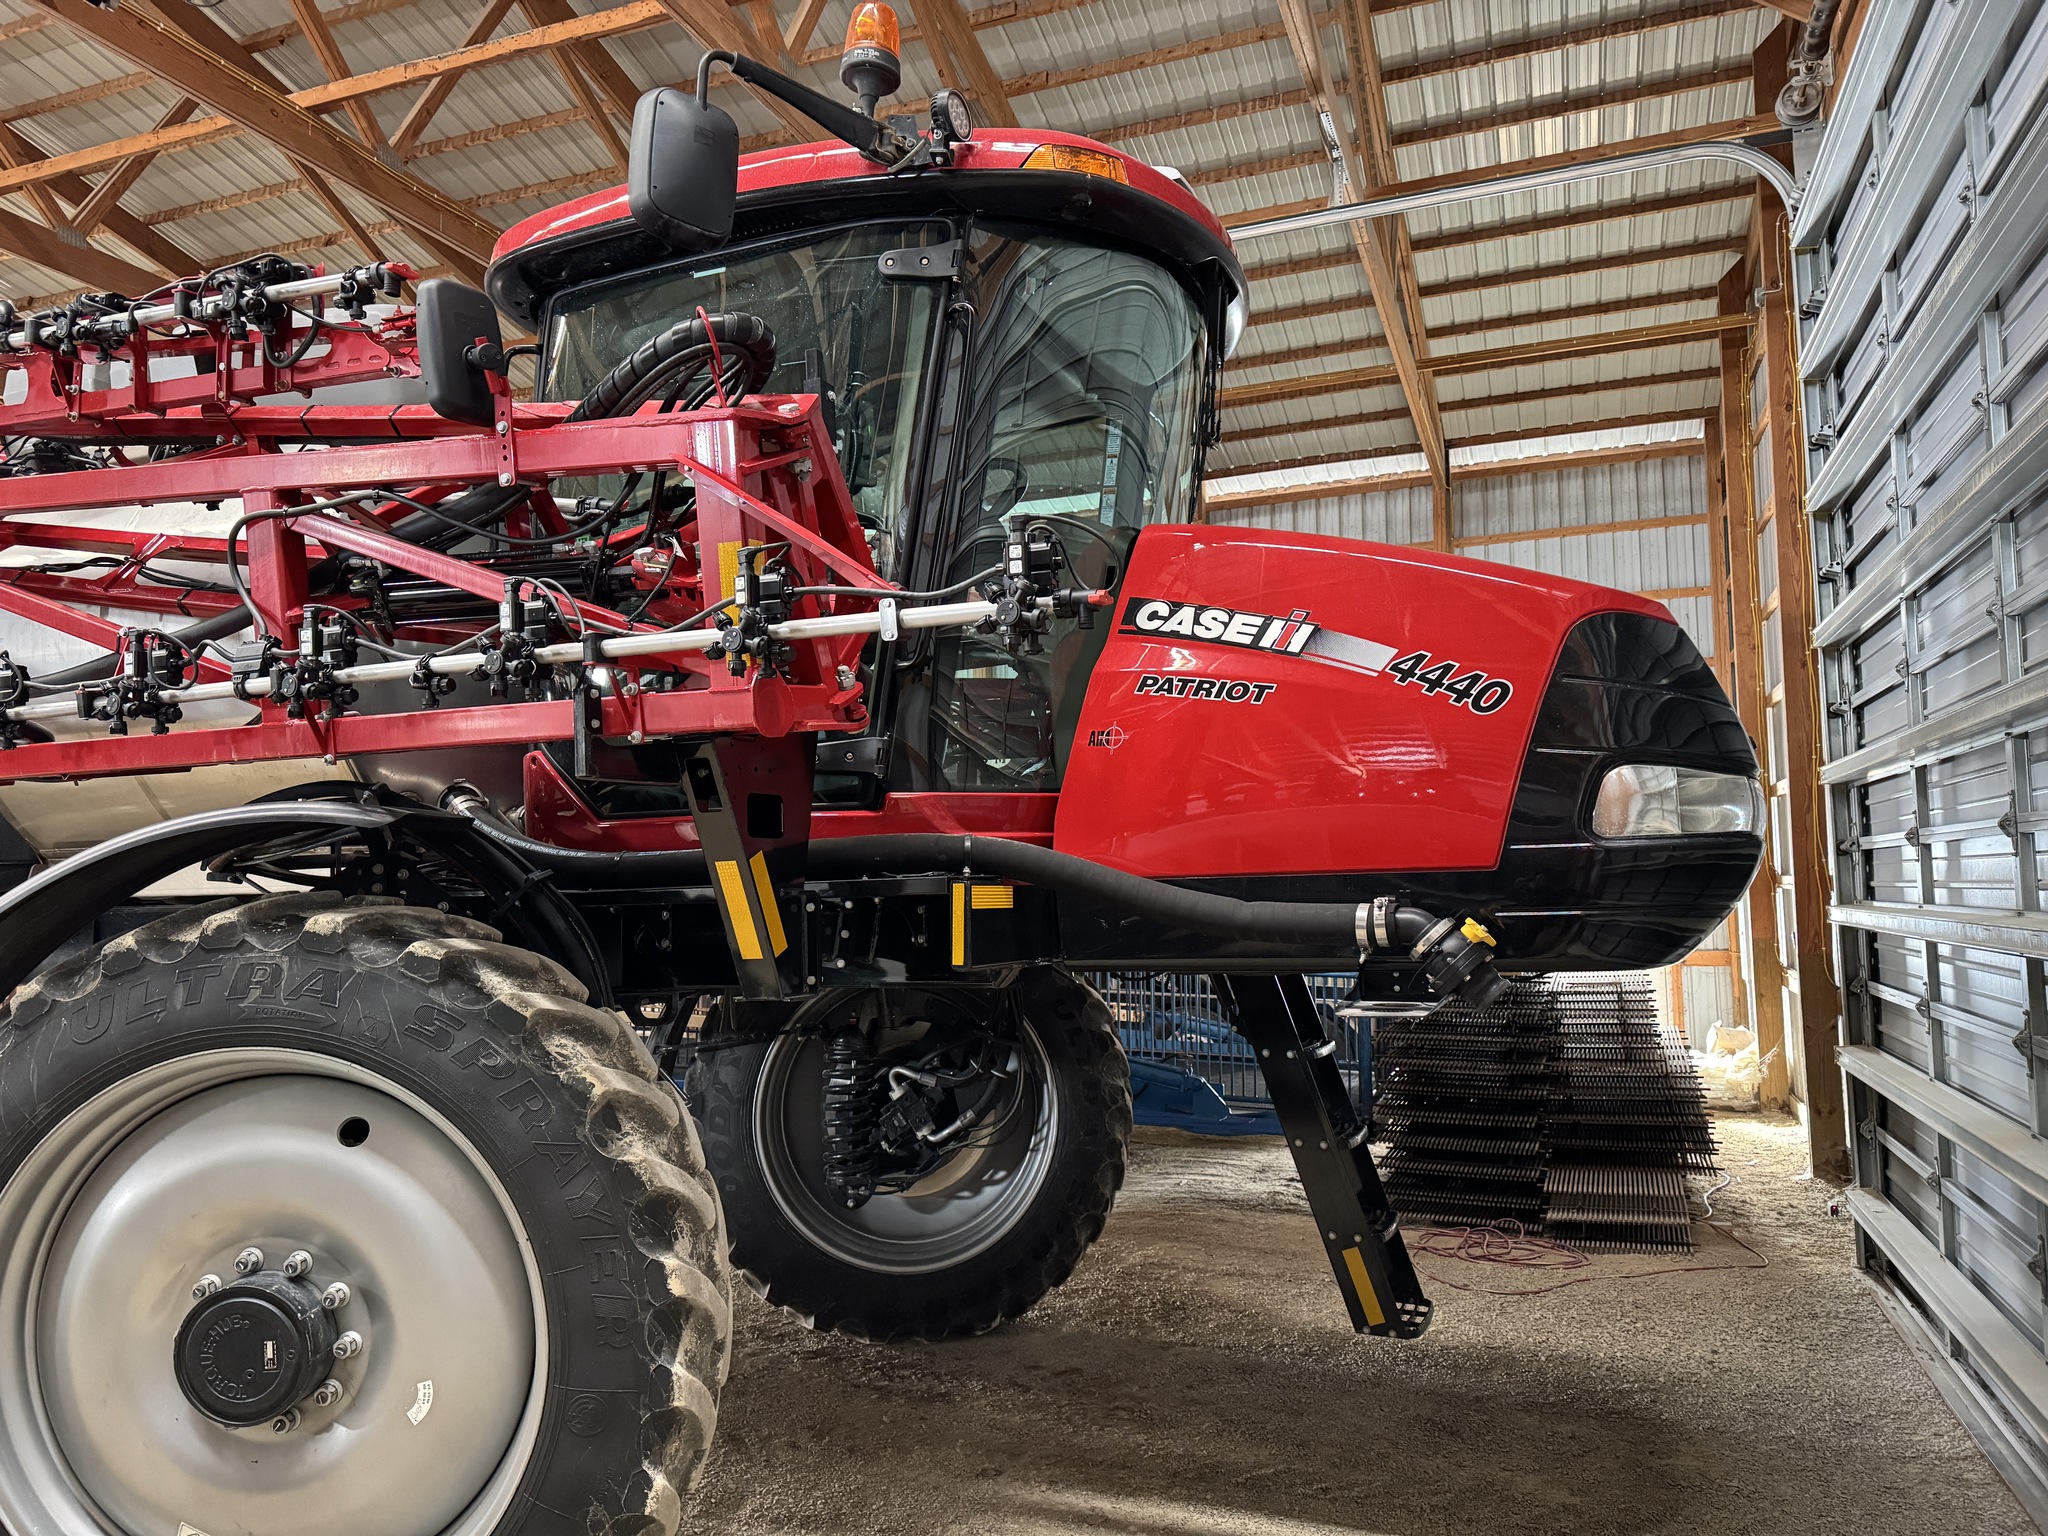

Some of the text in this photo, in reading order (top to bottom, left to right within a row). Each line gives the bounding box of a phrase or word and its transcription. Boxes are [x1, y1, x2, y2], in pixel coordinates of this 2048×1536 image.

[1134, 674, 1276, 705] PATRIOT
[1386, 650, 1513, 715] 4440
[70, 960, 342, 1044] ULTRA
[255, 1006, 307, 1019] ROTATION
[402, 1003, 634, 1348] SPRAYER
